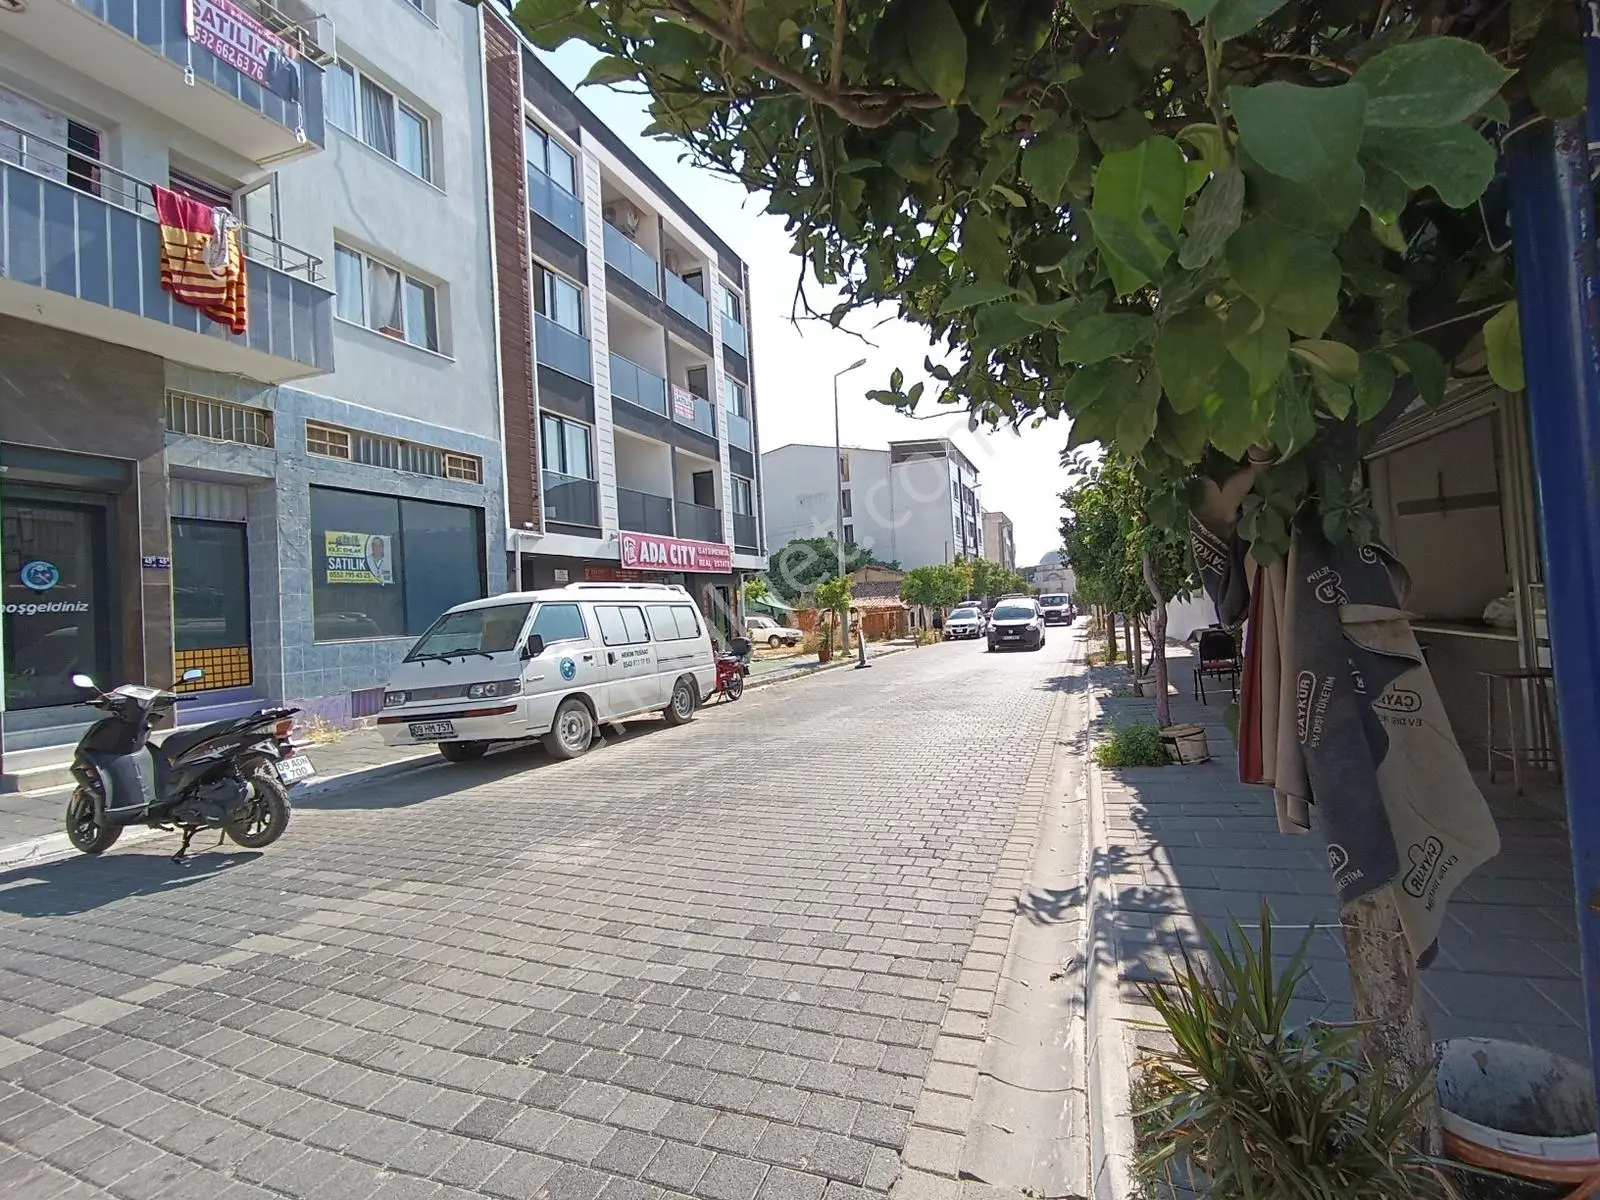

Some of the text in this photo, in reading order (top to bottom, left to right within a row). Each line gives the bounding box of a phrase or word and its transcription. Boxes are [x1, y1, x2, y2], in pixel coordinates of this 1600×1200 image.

[192, 1, 268, 63] SATILIK
[216, 39, 236, 62] 662
[236, 52, 250, 71] 63
[250, 63, 264, 80] 76
[328, 557, 366, 570] SATILIK
[640, 541, 667, 563] ADA
[669, 544, 696, 566] CITY
[1315, 676, 1337, 713] TÜKETİM
[1297, 679, 1311, 737] ÇAYKUR
[424, 722, 435, 733] HM
[436, 721, 450, 731] 757
[277, 757, 308, 772] 09 ADN
[289, 767, 308, 777] 700
